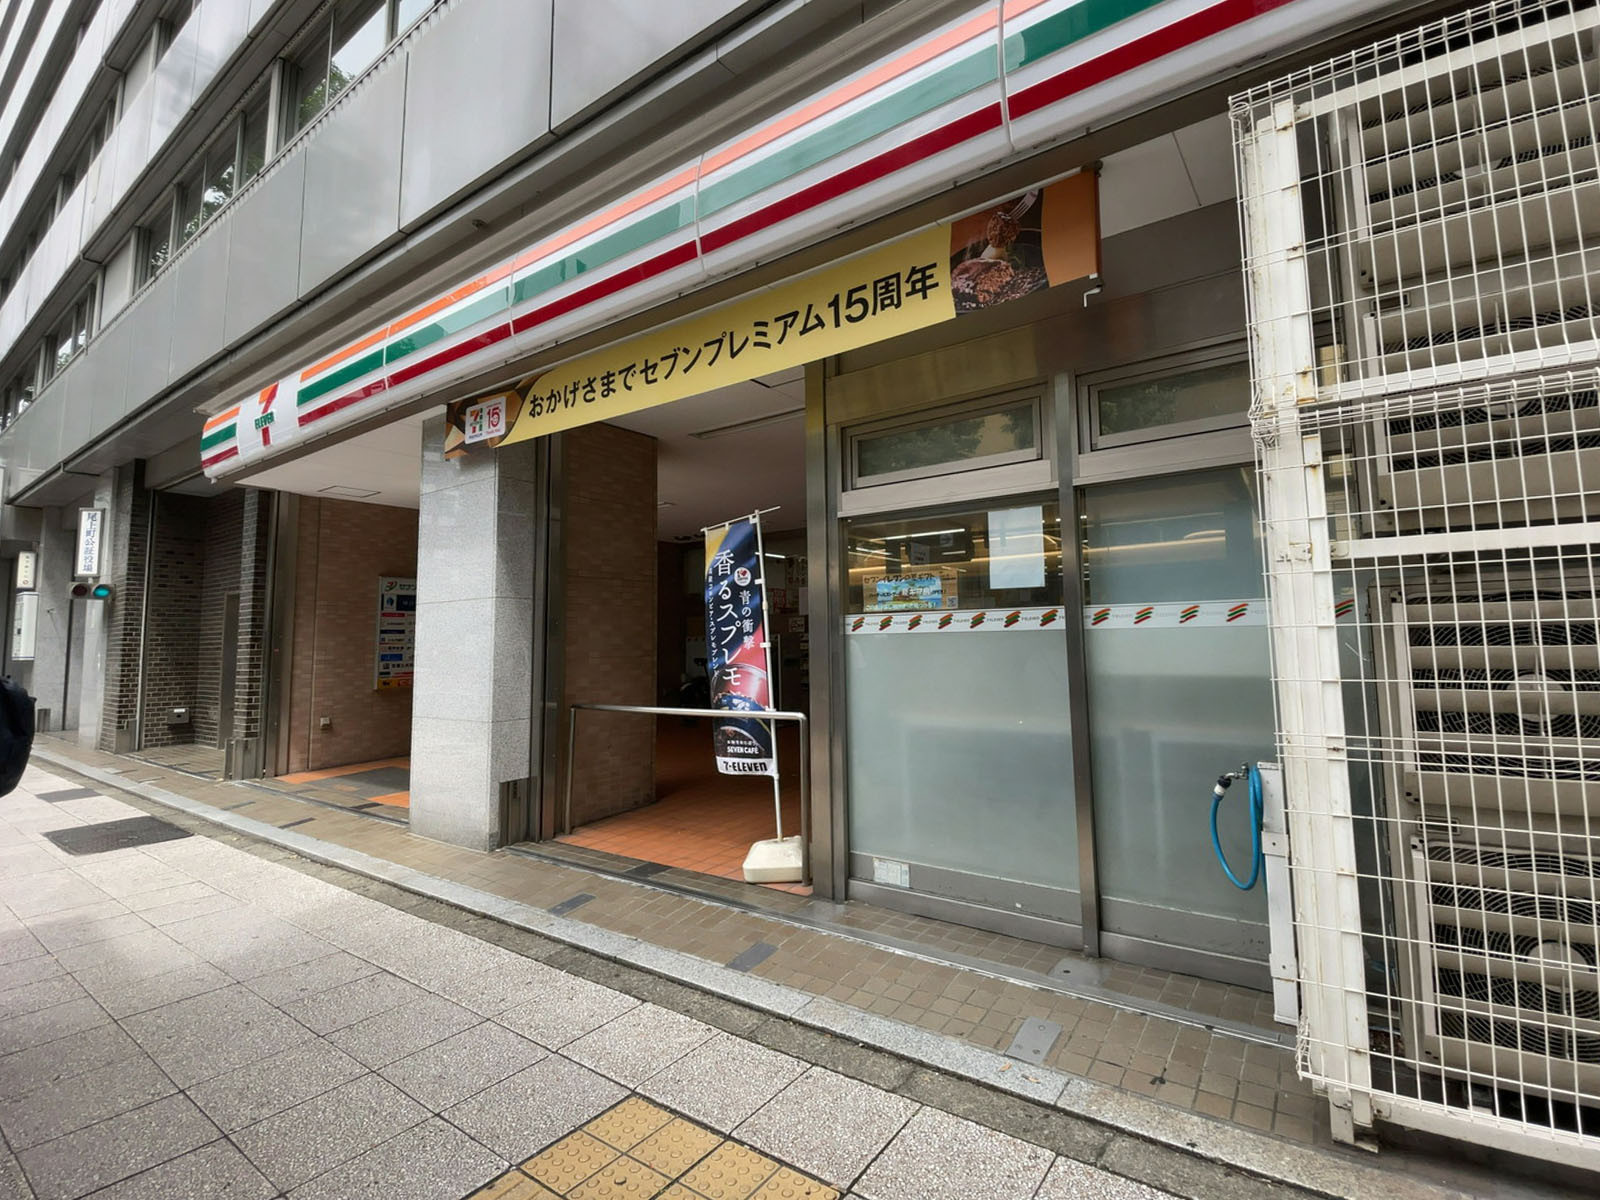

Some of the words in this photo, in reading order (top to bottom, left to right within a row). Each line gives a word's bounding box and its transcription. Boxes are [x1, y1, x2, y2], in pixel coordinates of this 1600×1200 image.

[528, 262, 940, 418] おかげさまでセブンプレミアム15周年
[714, 549, 742, 687] 香るスプレモ
